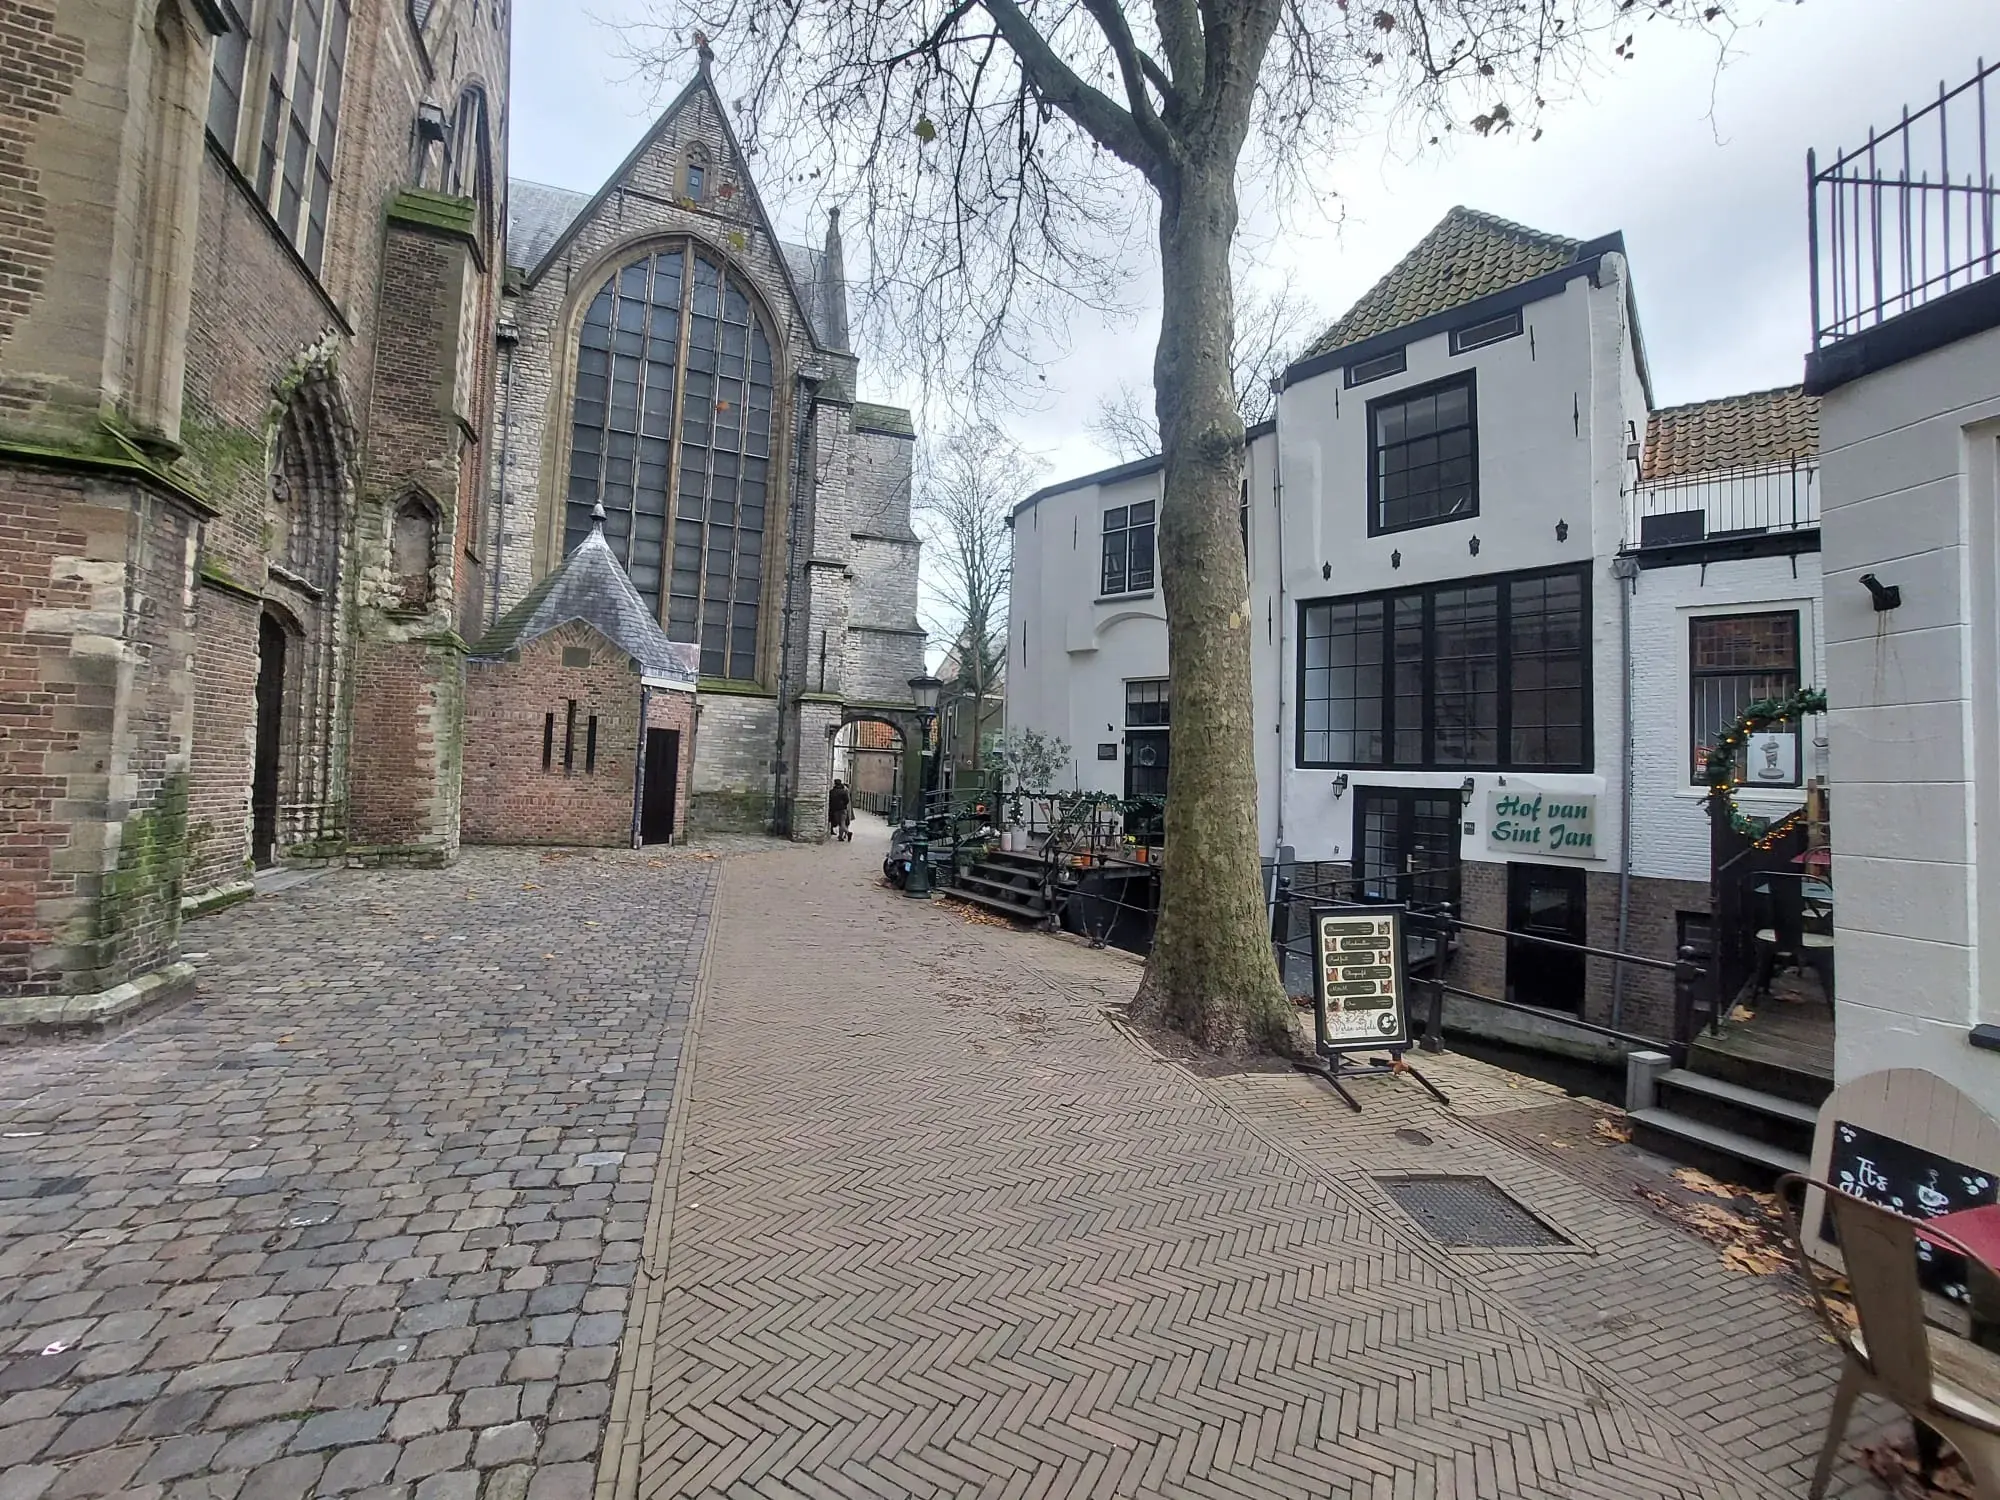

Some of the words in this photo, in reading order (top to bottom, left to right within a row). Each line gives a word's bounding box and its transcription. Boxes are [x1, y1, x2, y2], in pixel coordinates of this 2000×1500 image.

[1496, 795, 1542, 821] Hof
[1548, 804, 1588, 819] van
[1491, 821, 1541, 843] Sint
[1550, 824, 1593, 849] Jan
